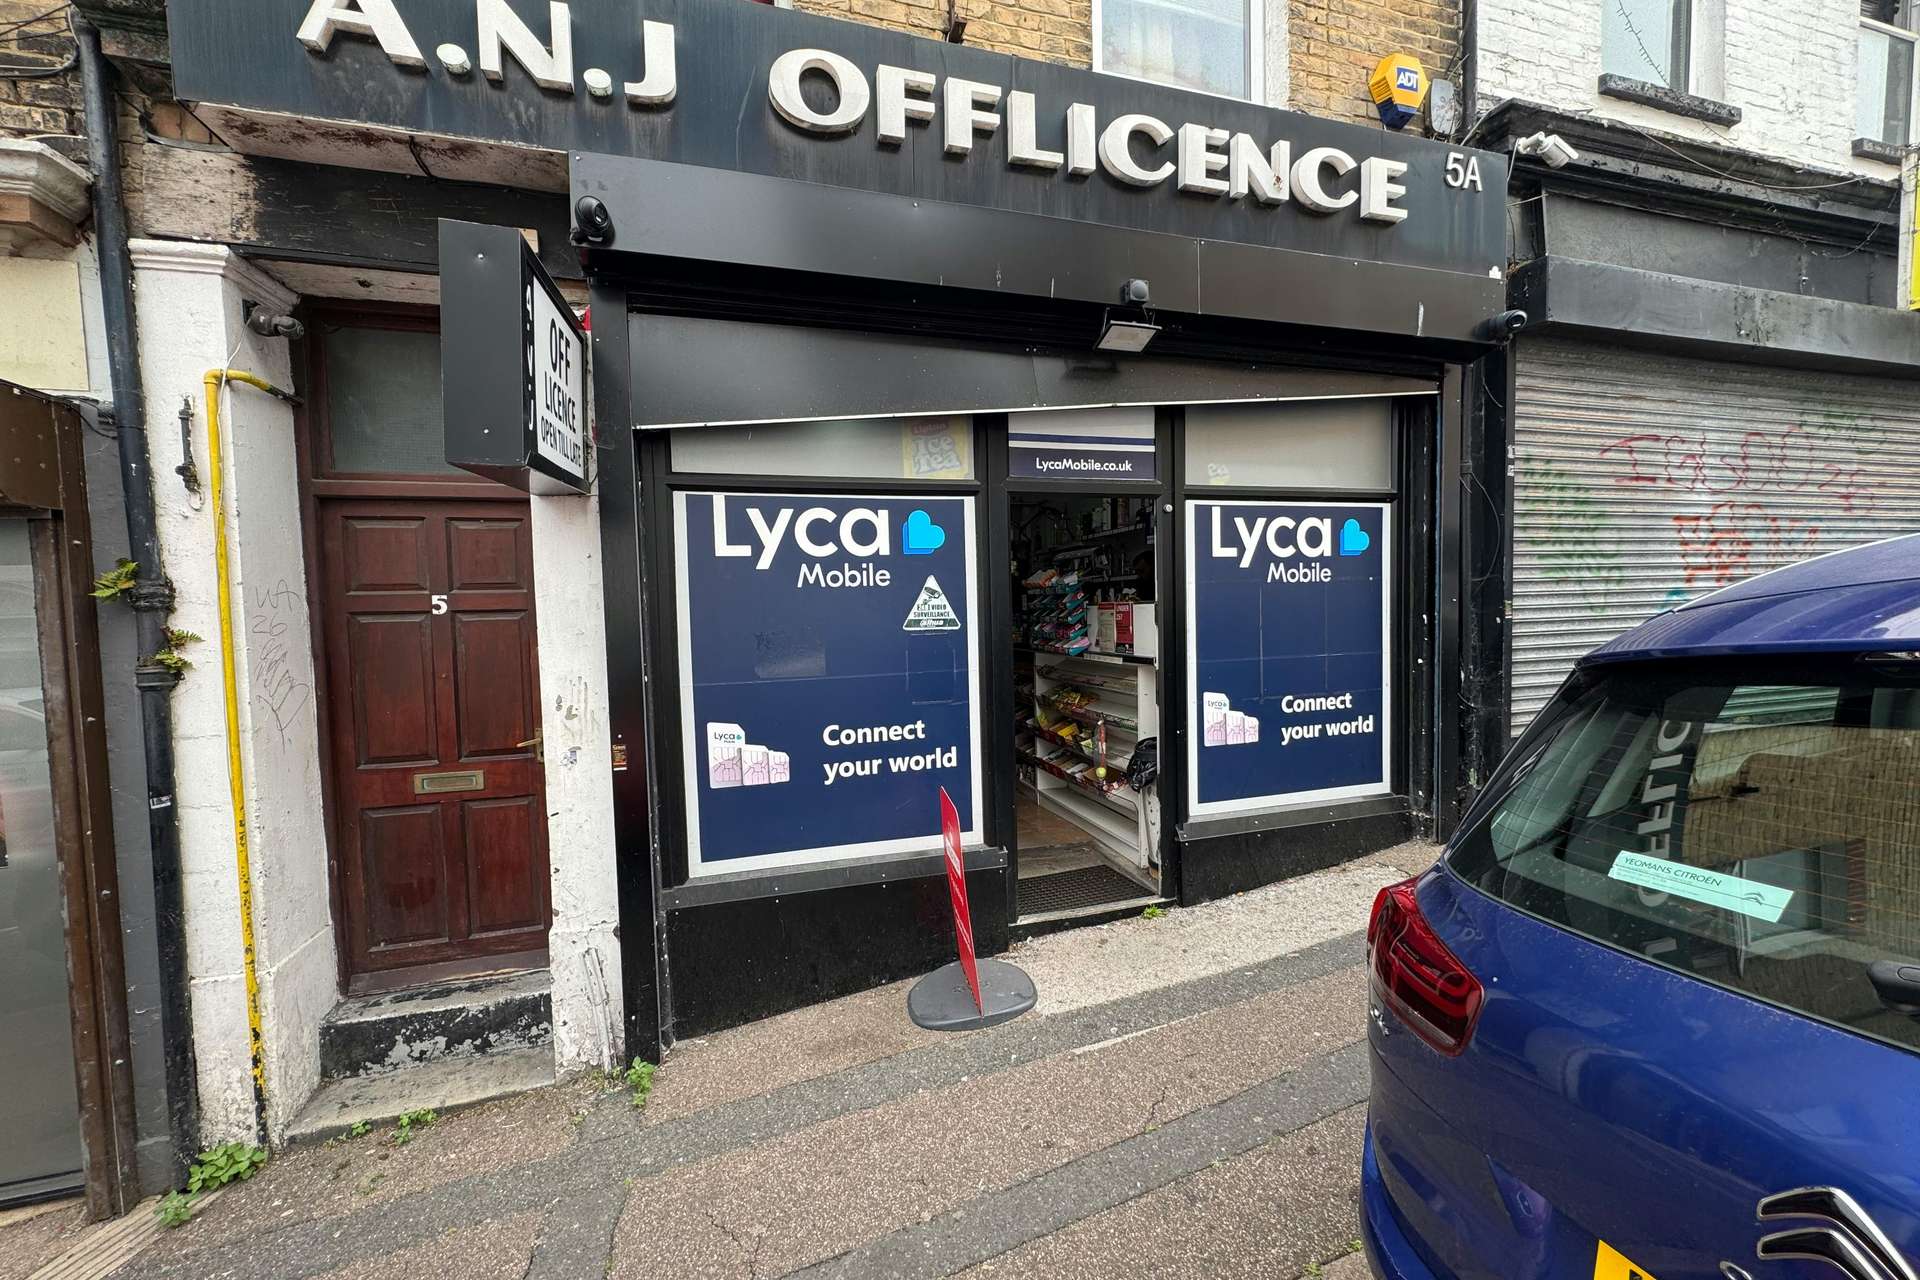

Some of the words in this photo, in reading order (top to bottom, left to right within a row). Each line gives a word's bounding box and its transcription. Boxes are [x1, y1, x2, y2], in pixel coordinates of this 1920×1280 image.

[296, 0, 677, 105] A.N.J
[1397, 72, 1418, 89] ADT
[1446, 152, 1483, 191] 5A
[549, 318, 571, 386] OFF
[544, 371, 577, 434] LICENCE
[541, 415, 558, 452] OPEN
[1036, 458, 1132, 472] LycaMobile.co.uk
[713, 495, 890, 570] Lyca
[1211, 506, 1331, 567] Lyca
[797, 563, 891, 588] Mobile
[1267, 562, 1331, 583] Mobile
[432, 595, 448, 615] 5
[1281, 693, 1352, 713] Connect
[714, 732, 735, 741] Lyca
[822, 720, 925, 745] Connect
[1281, 724, 1322, 746] your
[1325, 715, 1374, 736] world
[824, 757, 882, 785] your
[889, 747, 957, 772] world
[1625, 857, 1672, 874] YEOMANS
